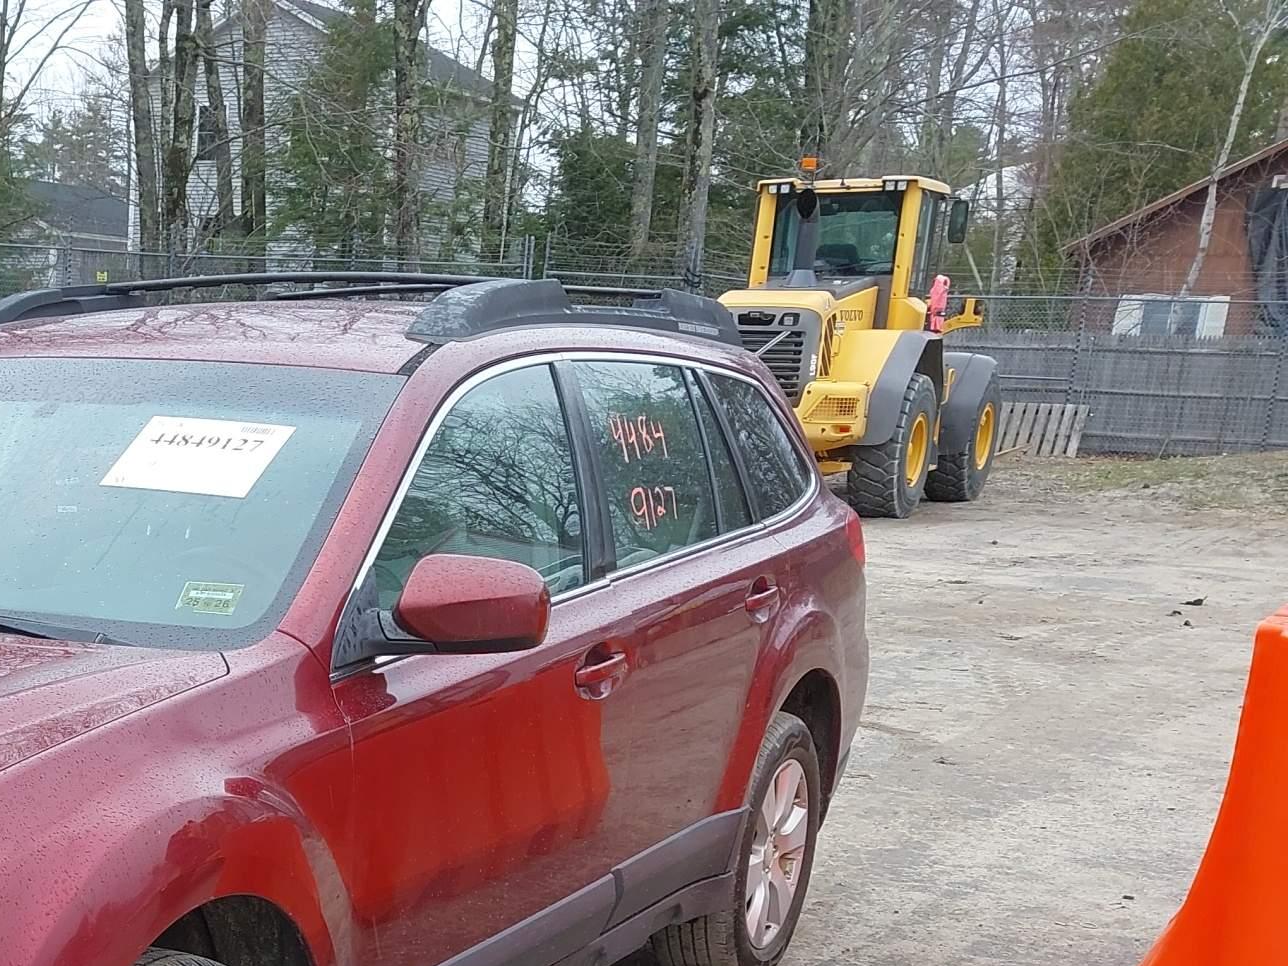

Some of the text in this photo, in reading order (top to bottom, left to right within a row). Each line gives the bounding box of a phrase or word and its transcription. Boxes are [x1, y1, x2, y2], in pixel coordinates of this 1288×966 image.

[839, 309, 865, 322] VOLVO
[149, 431, 266, 453] 44849127
[608, 413, 669, 464] 4484
[630, 486, 679, 531] 9127
